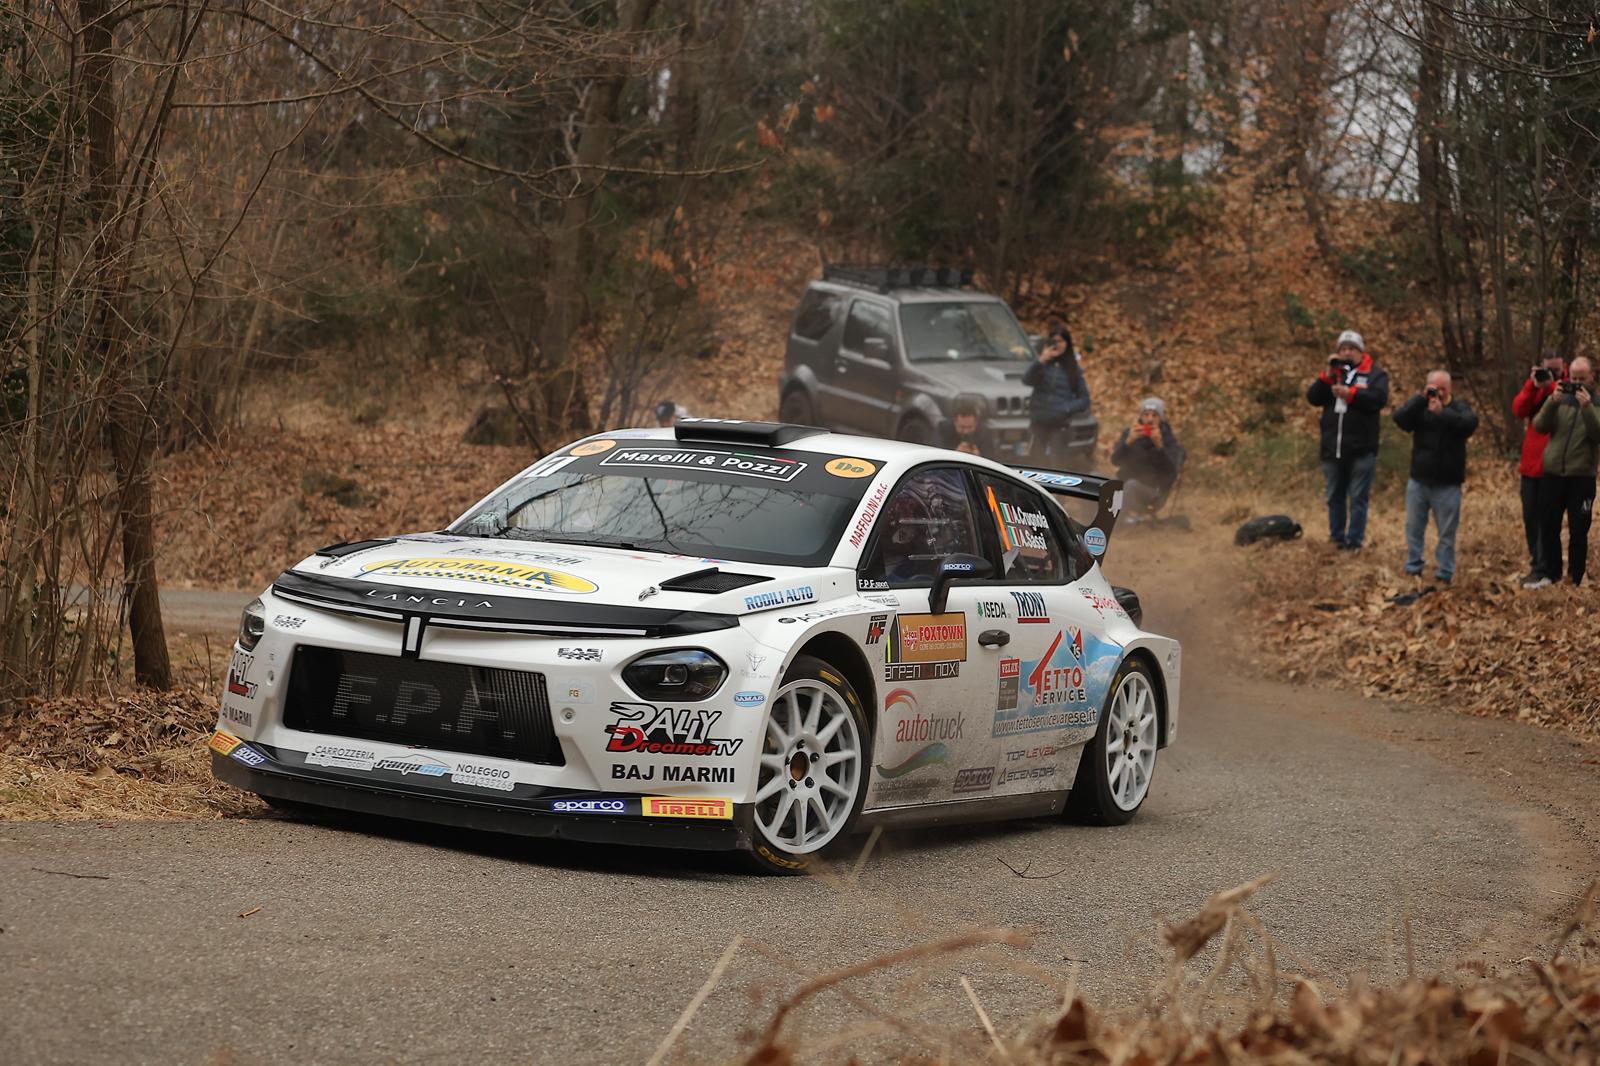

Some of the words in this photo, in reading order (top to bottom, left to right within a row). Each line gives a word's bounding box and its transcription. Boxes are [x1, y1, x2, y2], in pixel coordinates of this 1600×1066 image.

[615, 451, 697, 464] Marelli
[698, 454, 716, 466] &
[721, 457, 792, 476] Pozzi
[849, 497, 879, 549] MAFFIOLINI
[353, 559, 552, 585] AUTOMANIA
[366, 589, 493, 608] LANCIA
[744, 592, 784, 611] RODILI
[786, 585, 814, 602] AUTO
[1009, 591, 1048, 617] TRONY
[982, 601, 1007, 619] ISEDA
[919, 625, 964, 642] FOXTOWN
[332, 672, 516, 739] F.P.F.
[1035, 689, 1086, 705] SERVICE
[895, 711, 966, 743] autotruck
[315, 745, 375, 761] CARROZZERIA
[456, 764, 510, 779] NOLEGGIO
[612, 764, 655, 781] BAJ
[662, 765, 735, 783] MARMI
[553, 801, 625, 813] sparco
[650, 800, 725, 817] PIRELLI
